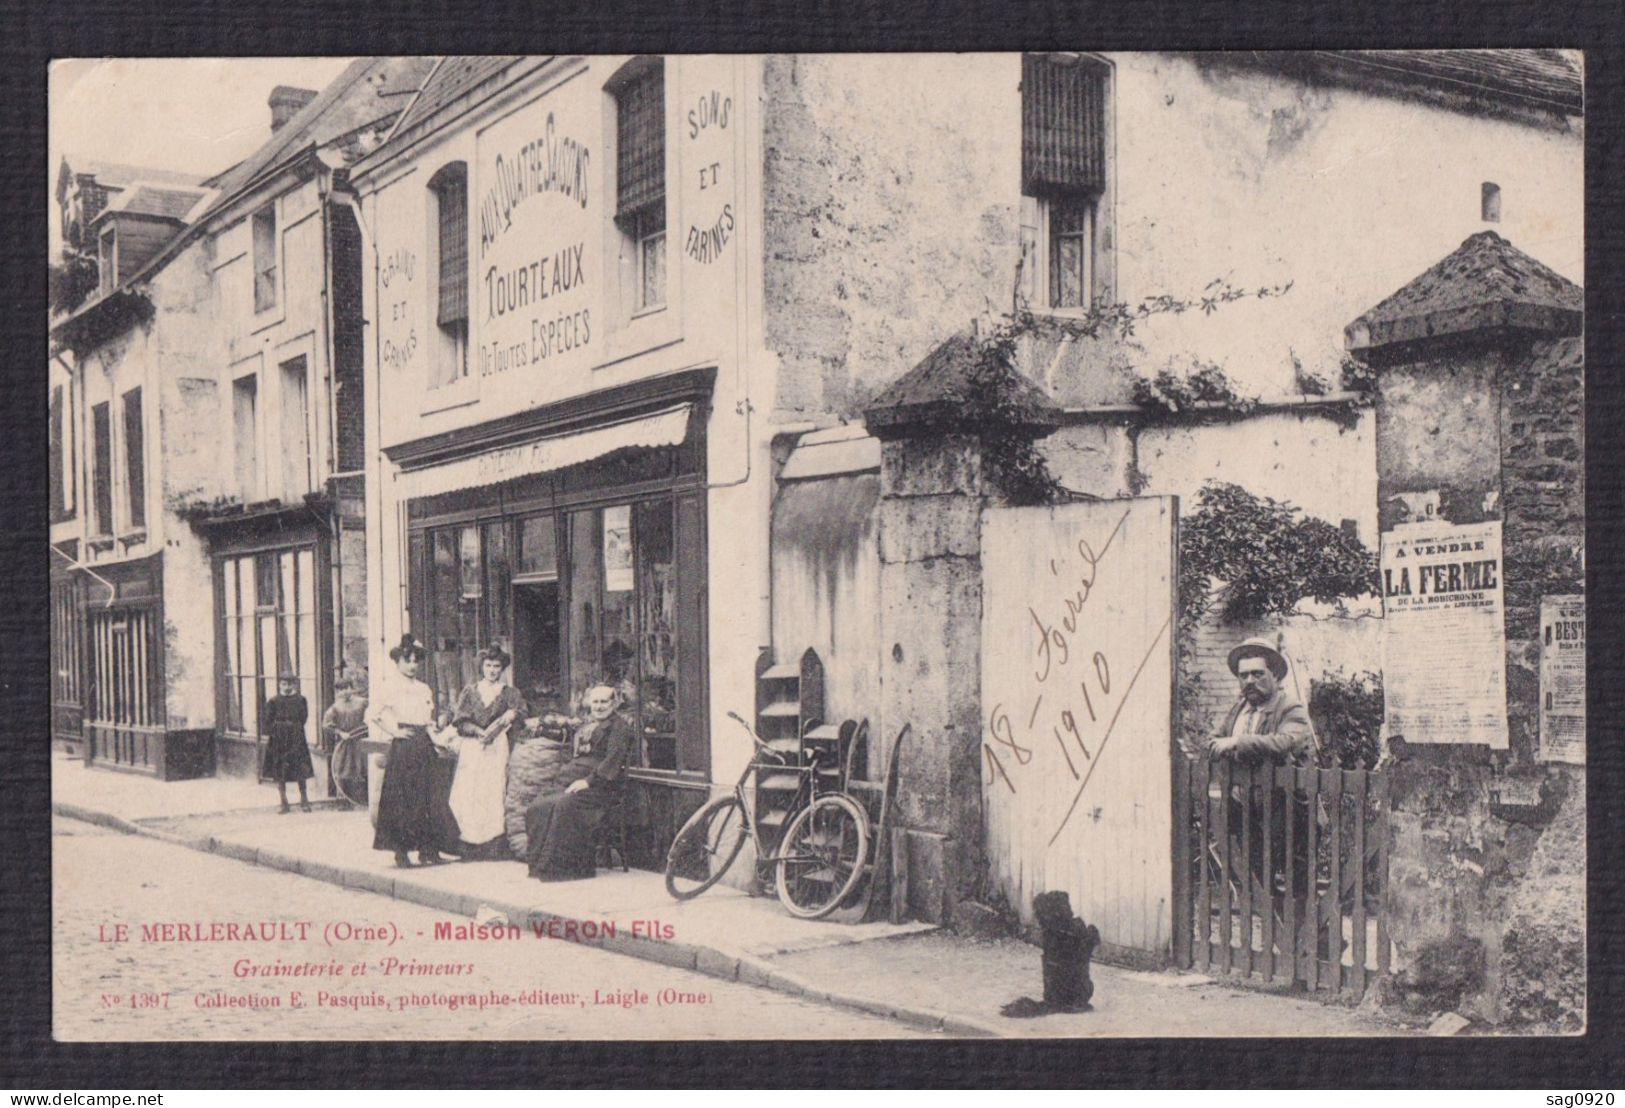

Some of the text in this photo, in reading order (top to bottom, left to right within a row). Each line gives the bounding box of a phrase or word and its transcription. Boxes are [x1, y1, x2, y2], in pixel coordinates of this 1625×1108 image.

[688, 90, 732, 140] SONS
[481, 111, 590, 260] AUX QUATRE SAISONS
[699, 162, 720, 190] ET
[685, 203, 734, 265] FARINES
[484, 241, 584, 327] TOURTEAUX
[393, 300, 407, 321] ET
[1396, 541, 1485, 558] A VENDRE
[1384, 559, 1498, 598] LA FERME
[1412, 597, 1424, 605] LA
[1054, 651, 1111, 782] 1910
